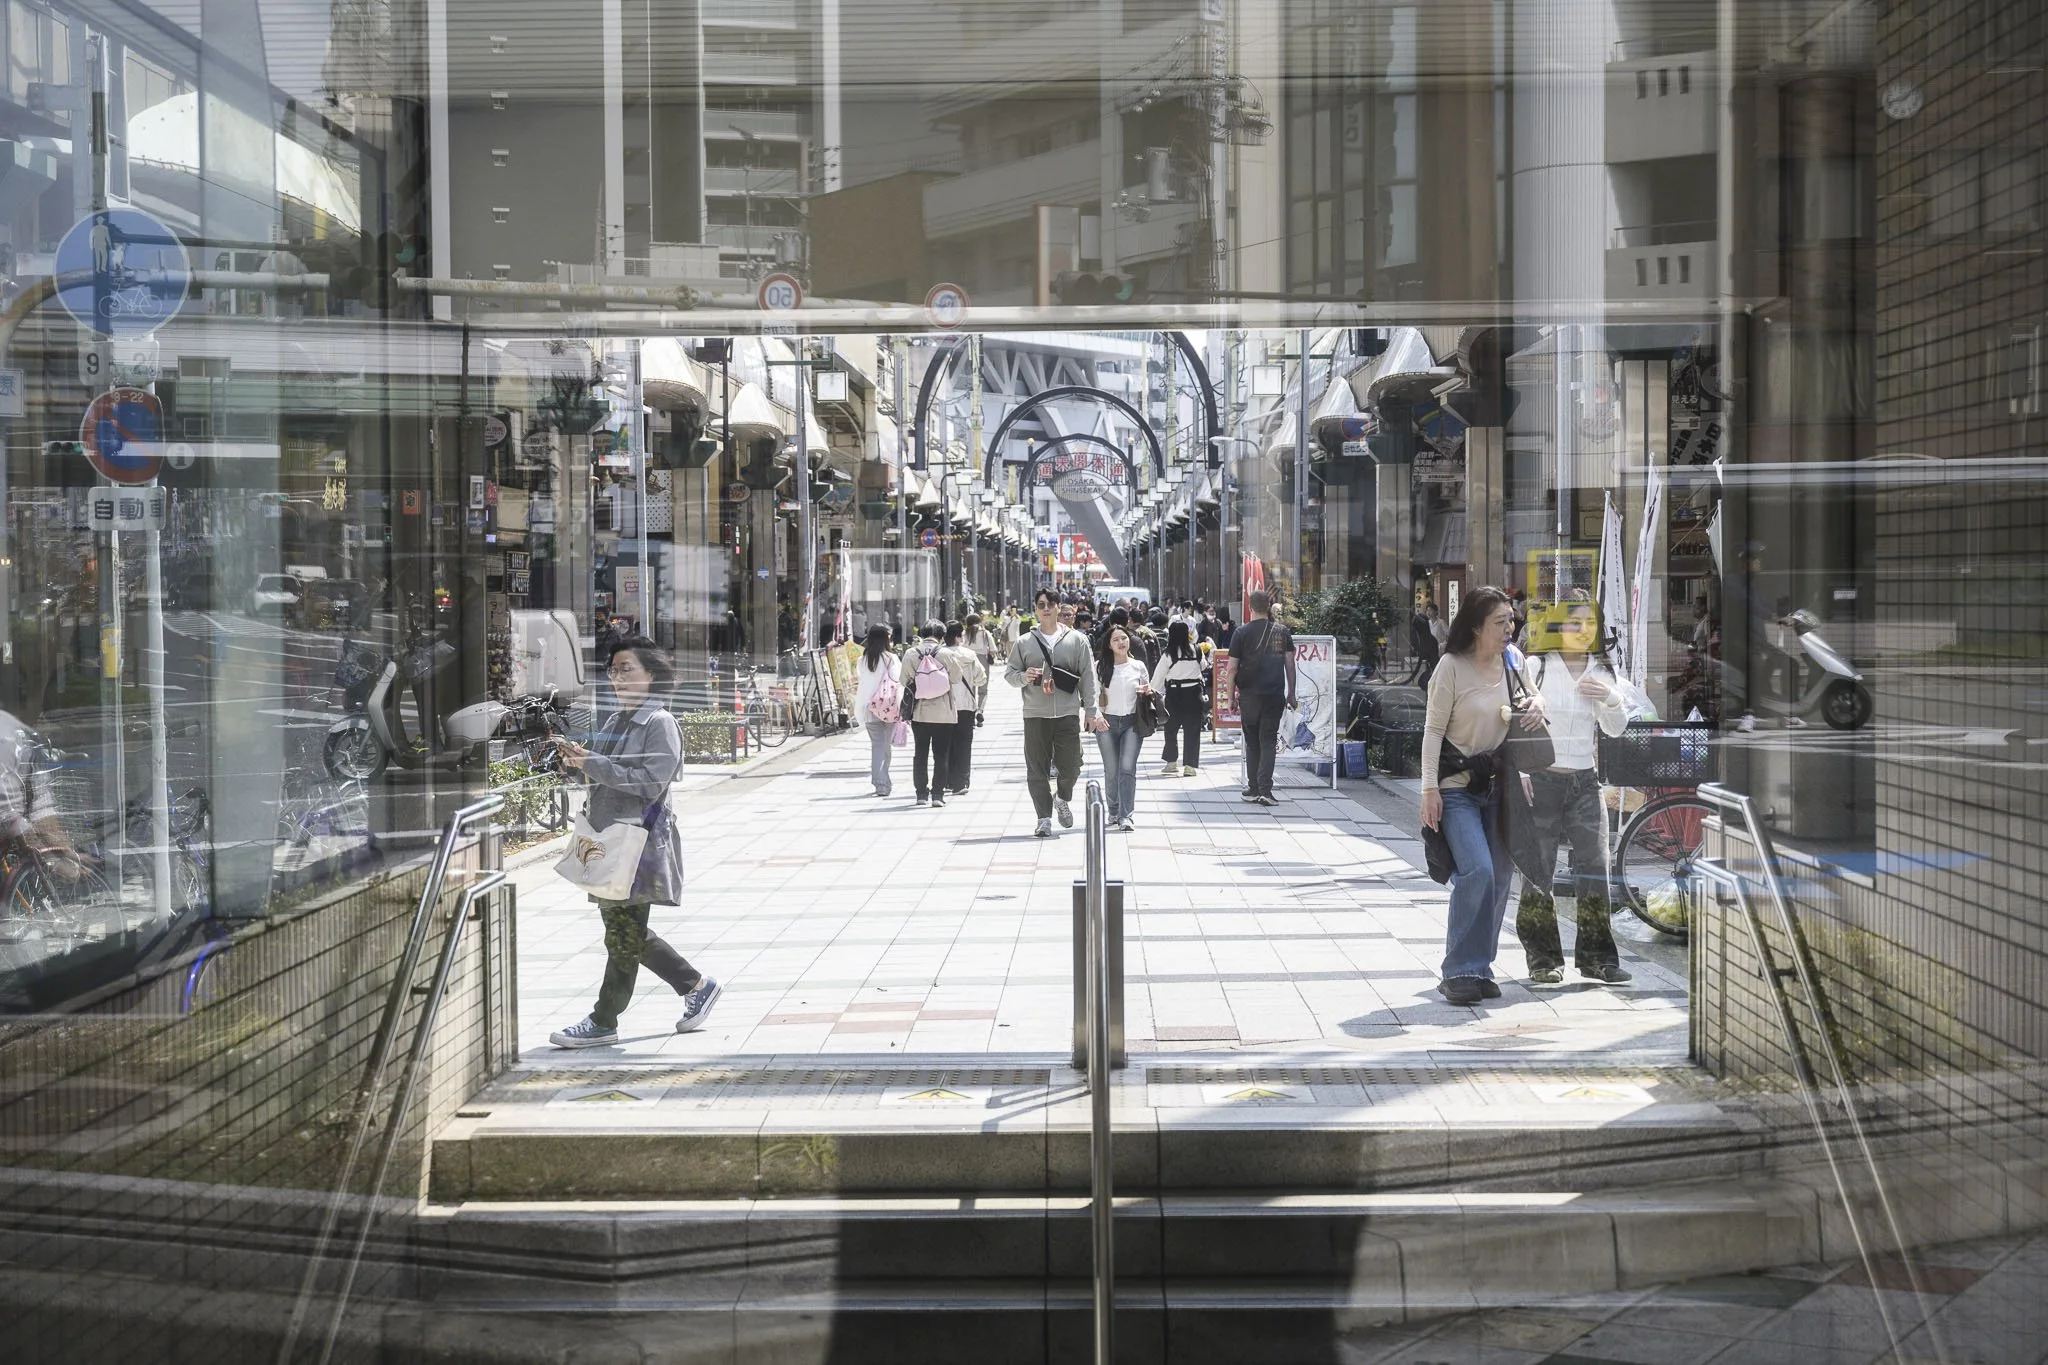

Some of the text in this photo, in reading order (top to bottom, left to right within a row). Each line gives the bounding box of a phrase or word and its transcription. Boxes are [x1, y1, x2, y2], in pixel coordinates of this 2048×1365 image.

[86, 353, 99, 375] 9
[94, 498, 162, 520] 自動車
